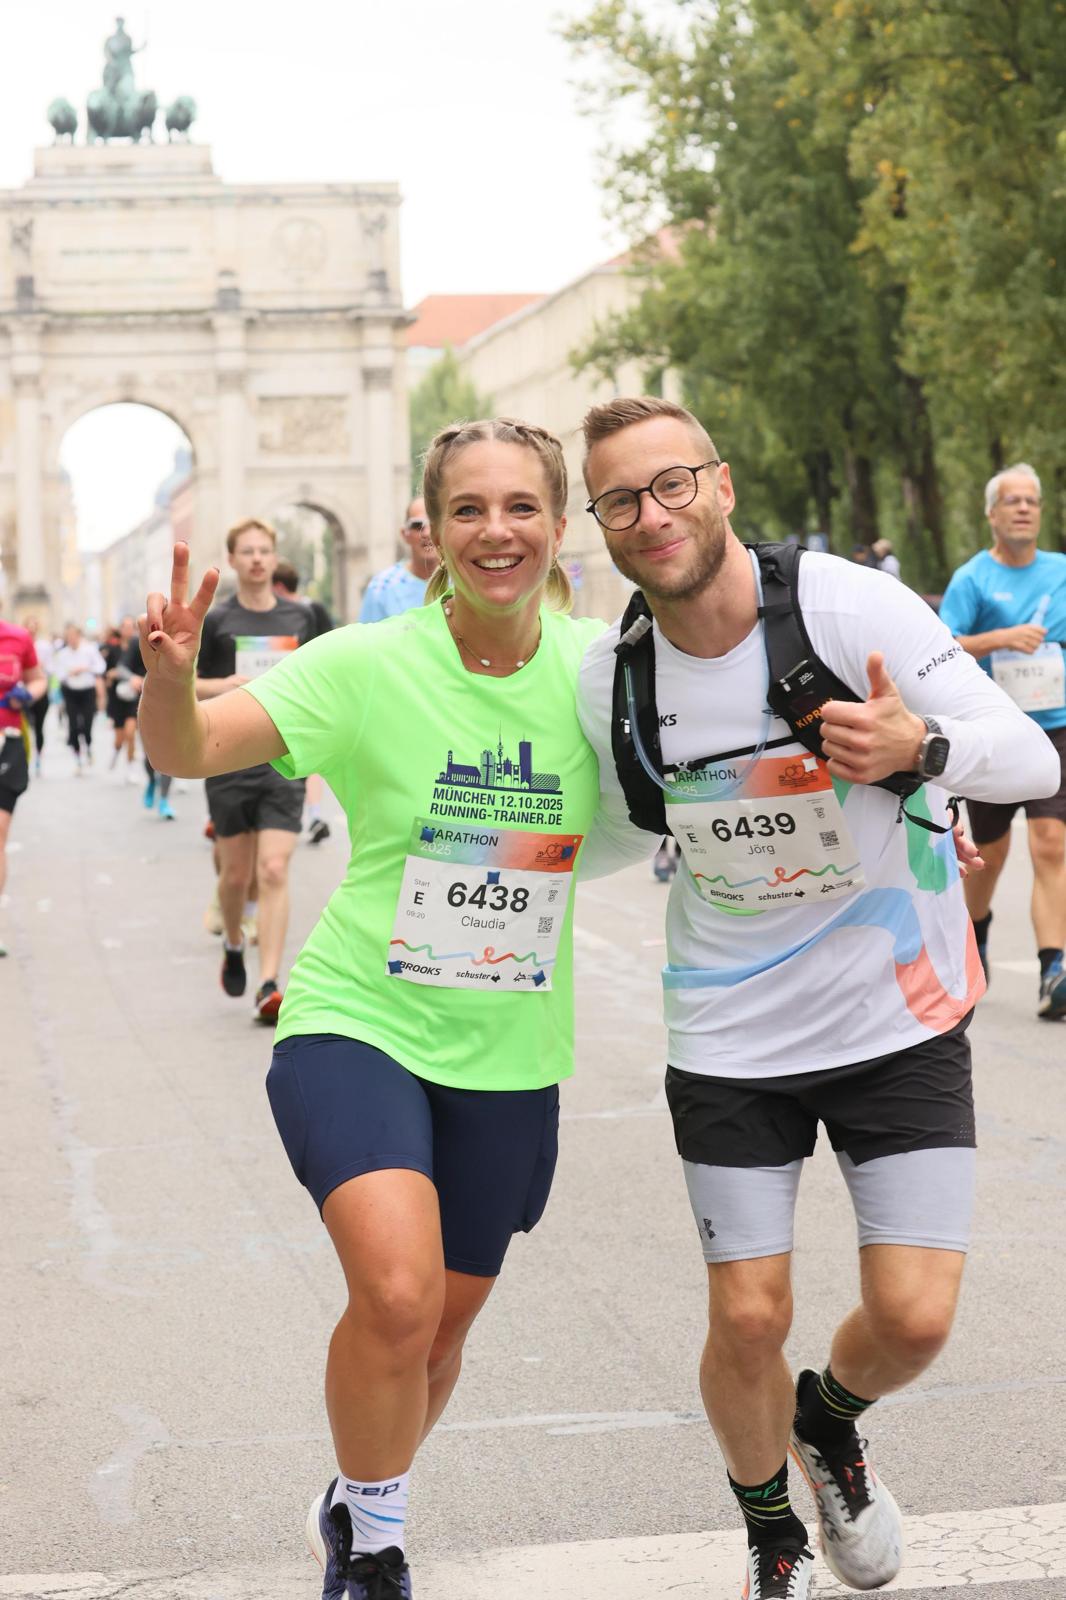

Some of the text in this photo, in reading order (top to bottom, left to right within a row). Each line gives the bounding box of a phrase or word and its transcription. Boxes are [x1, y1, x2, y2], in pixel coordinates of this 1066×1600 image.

[658, 713, 677, 727] KS
[795, 700, 828, 728] KIPR
[432, 786, 563, 811] MÜNCHEN 12.10.2025
[430, 802, 563, 826] RUNNING-TRAINER.DE
[711, 812, 796, 842] 6439
[421, 826, 499, 847] ARATHON
[686, 832, 699, 843] E
[420, 841, 452, 856] 2025
[748, 843, 776, 855] Jörg
[414, 878, 431, 888] Start
[413, 891, 425, 905] E
[447, 881, 530, 913] 6438
[710, 888, 745, 902] BROOKS
[758, 891, 793, 902] schuster
[406, 909, 426, 919] 09:20
[461, 915, 506, 930] Claudia
[399, 960, 443, 976] BROOKS
[455, 970, 491, 981] schuster
[346, 1482, 400, 1497] cep
